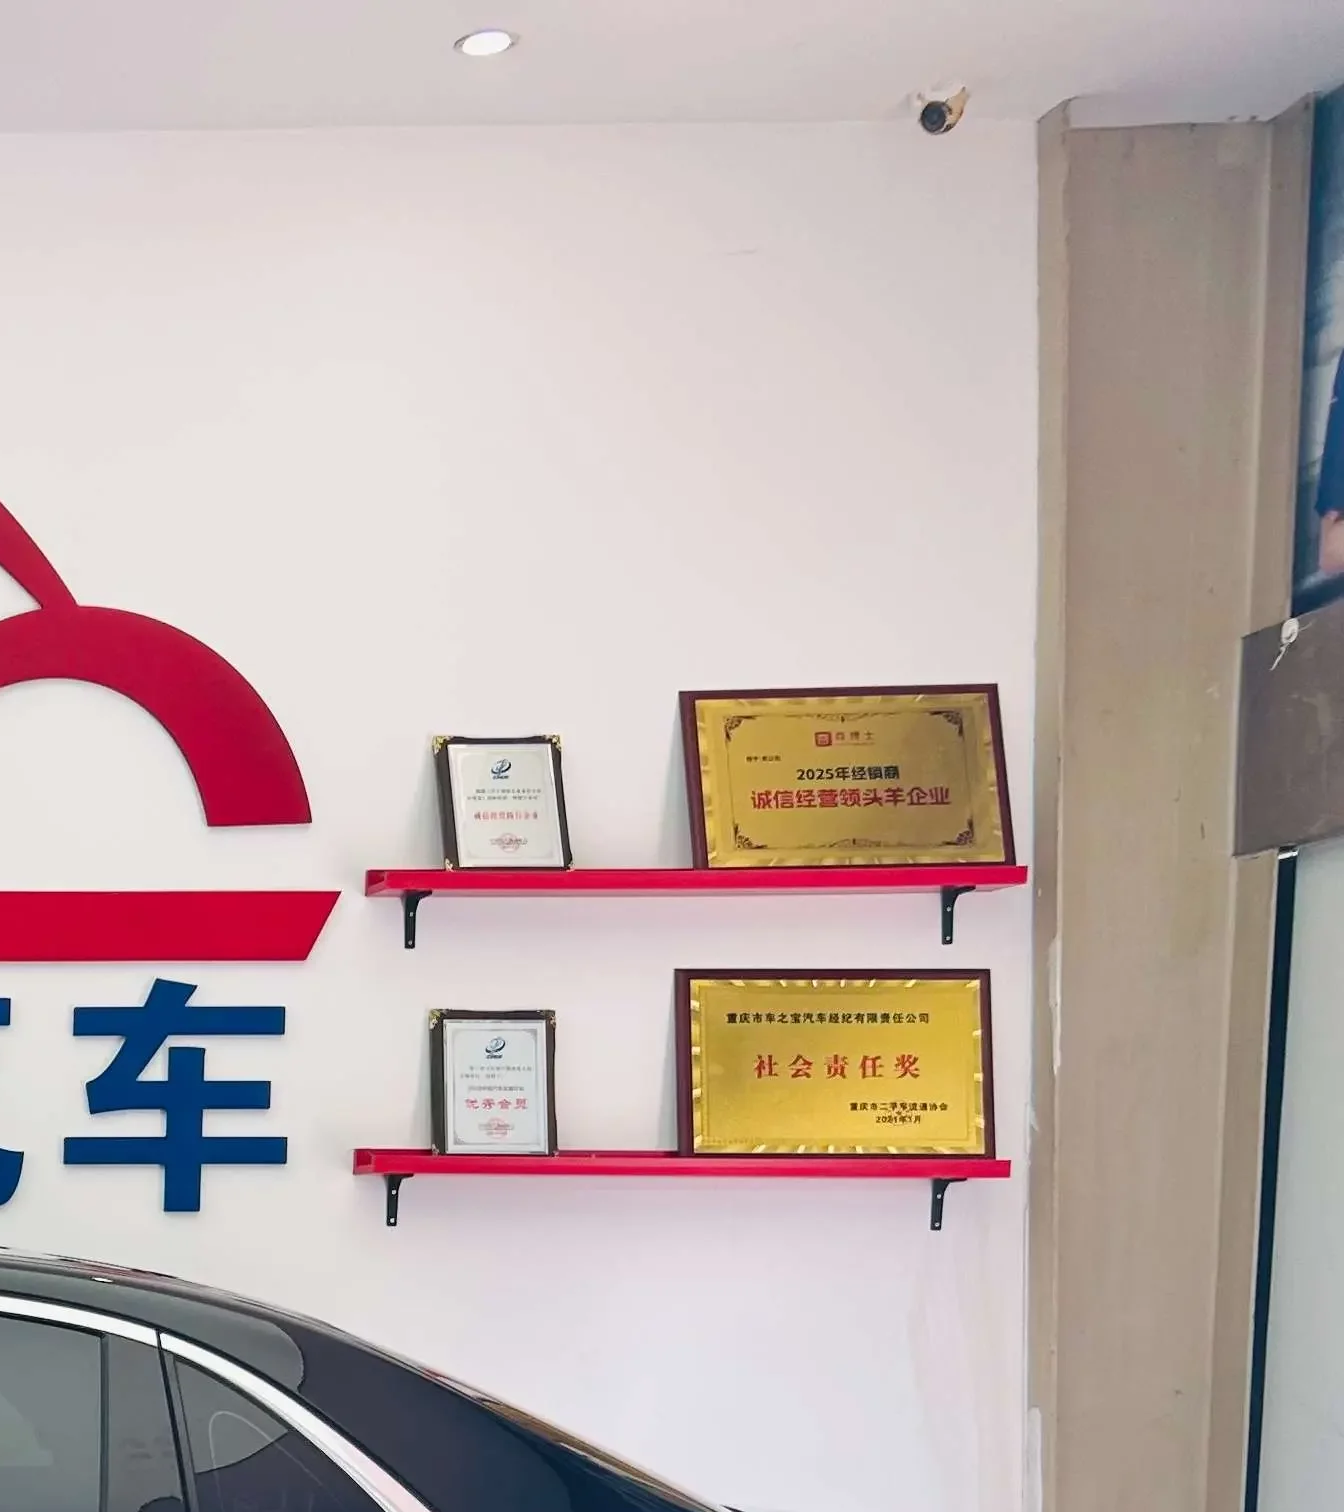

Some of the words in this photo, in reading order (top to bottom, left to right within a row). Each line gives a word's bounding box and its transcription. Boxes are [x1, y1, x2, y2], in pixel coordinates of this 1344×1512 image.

[796, 765, 900, 781] 2025年经销商
[750, 786, 952, 811] 诚信经营领头羊企业
[726, 1012, 930, 1025] 重庆市车之宝汽车经纪有限责任公司
[754, 1053, 921, 1080] 社会责任奖
